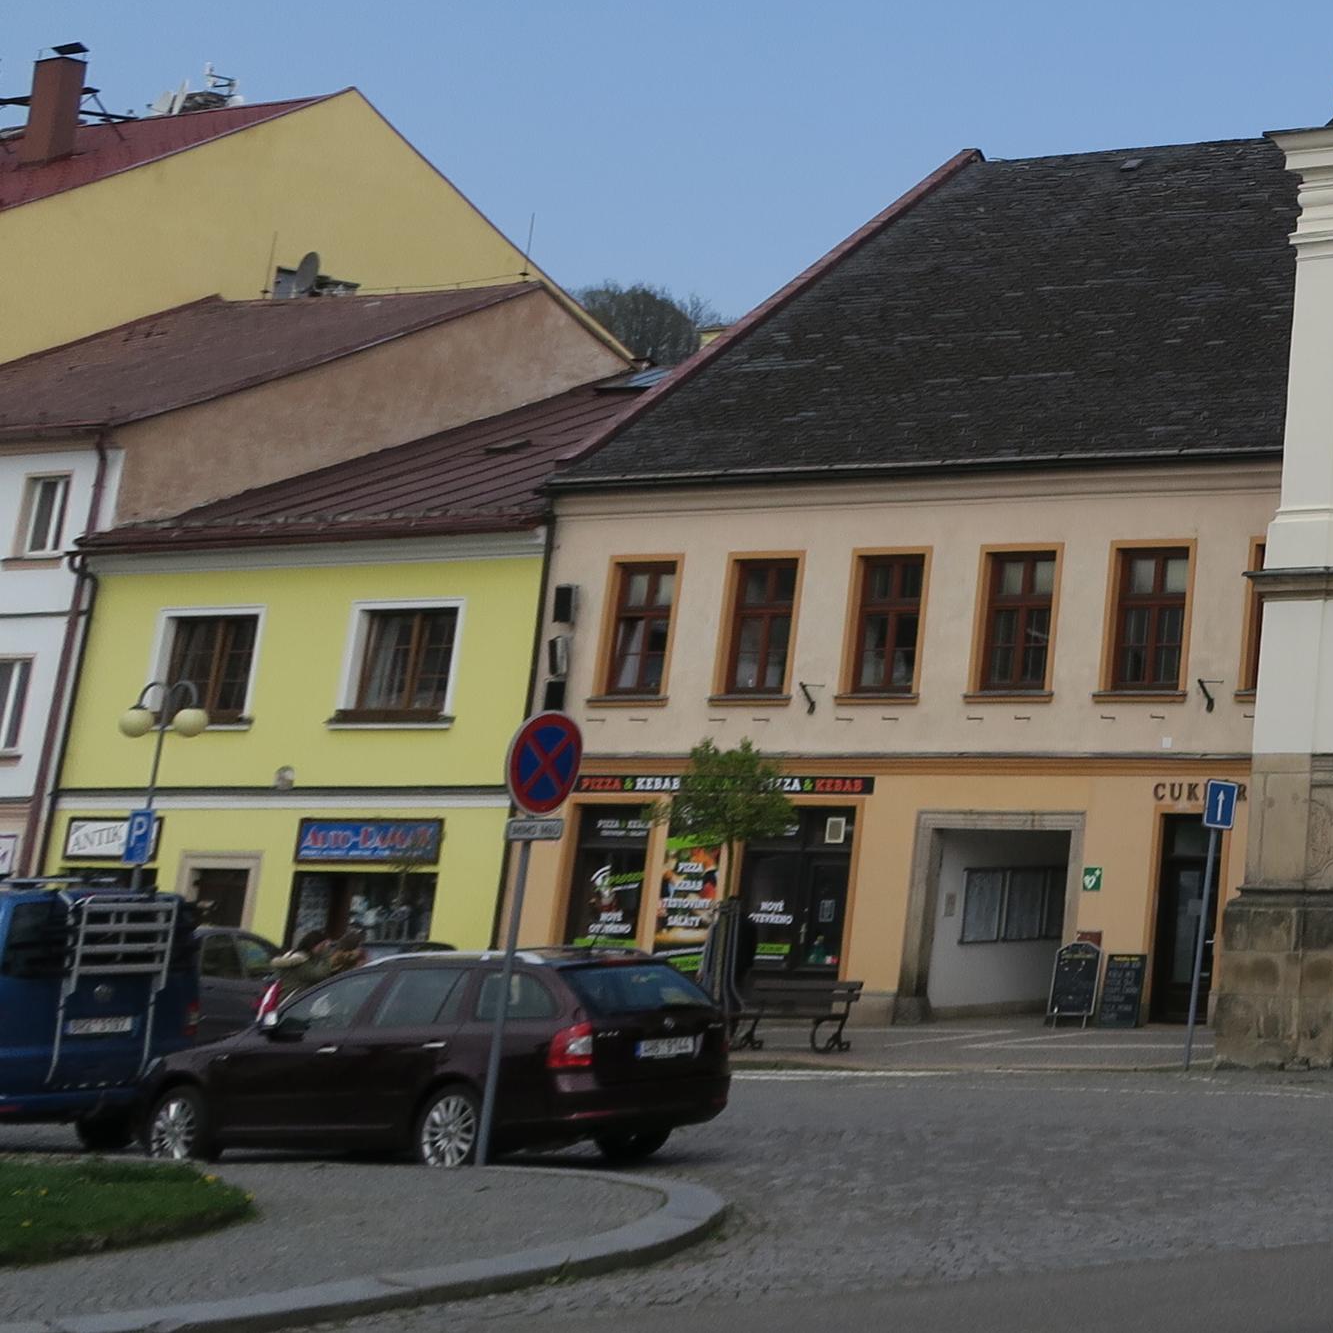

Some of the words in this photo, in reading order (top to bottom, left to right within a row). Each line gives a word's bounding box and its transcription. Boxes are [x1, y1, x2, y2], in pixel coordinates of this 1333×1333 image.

[580, 777, 622, 790] PIZZA
[634, 777, 681, 790] KEBAB
[815, 779, 864, 792] KEBAB
[129, 817, 147, 847] P
